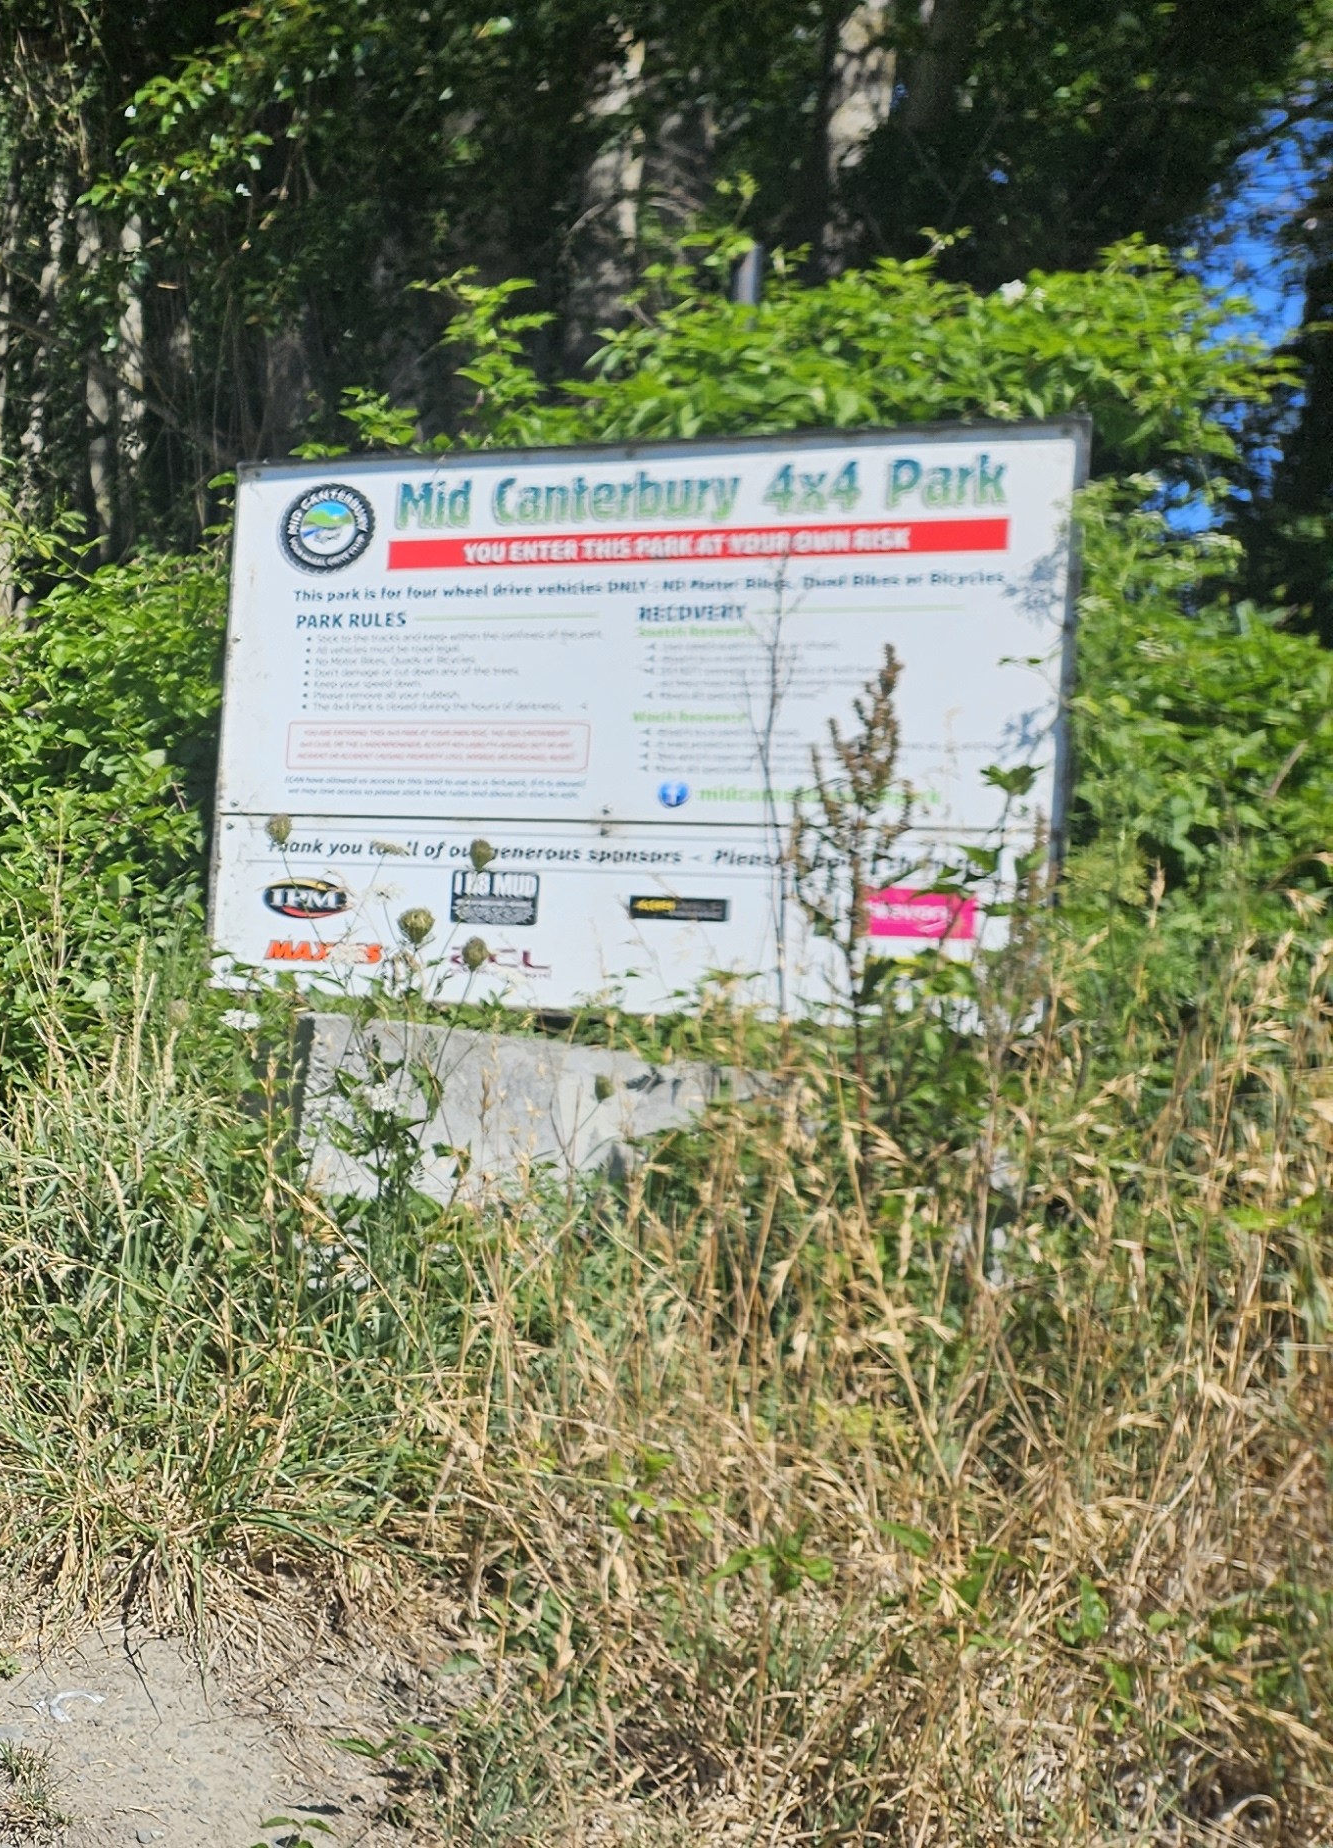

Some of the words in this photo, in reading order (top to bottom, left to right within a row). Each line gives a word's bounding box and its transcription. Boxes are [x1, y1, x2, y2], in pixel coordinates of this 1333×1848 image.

[395, 479, 472, 530] Mid
[493, 470, 741, 526] Canterbury
[764, 460, 862, 514] 4x4
[886, 453, 1008, 511] Park
[287, 508, 303, 535] MID
[463, 541, 506, 564] YOU
[509, 539, 579, 562] ENTER
[580, 537, 631, 561] THIS
[635, 535, 692, 560] PARK
[695, 533, 724, 556] AT
[727, 531, 790, 555] YOUR
[791, 530, 850, 553] OWN
[852, 527, 911, 551] RISK
[295, 589, 323, 601] This
[327, 588, 359, 602] park
[364, 587, 375, 599] is
[380, 587, 401, 598] for
[406, 586, 437, 598] four
[442, 584, 488, 597] wheel
[493, 583, 532, 595] drive
[537, 581, 602, 594] vehicles
[296, 612, 343, 629] PARK
[349, 610, 407, 628] RULES
[639, 603, 747, 621] RECOVERY
[326, 843, 363, 858] you
[424, 841, 446, 860] of
[589, 849, 683, 865] sponsors
[492, 873, 538, 899] MUD
